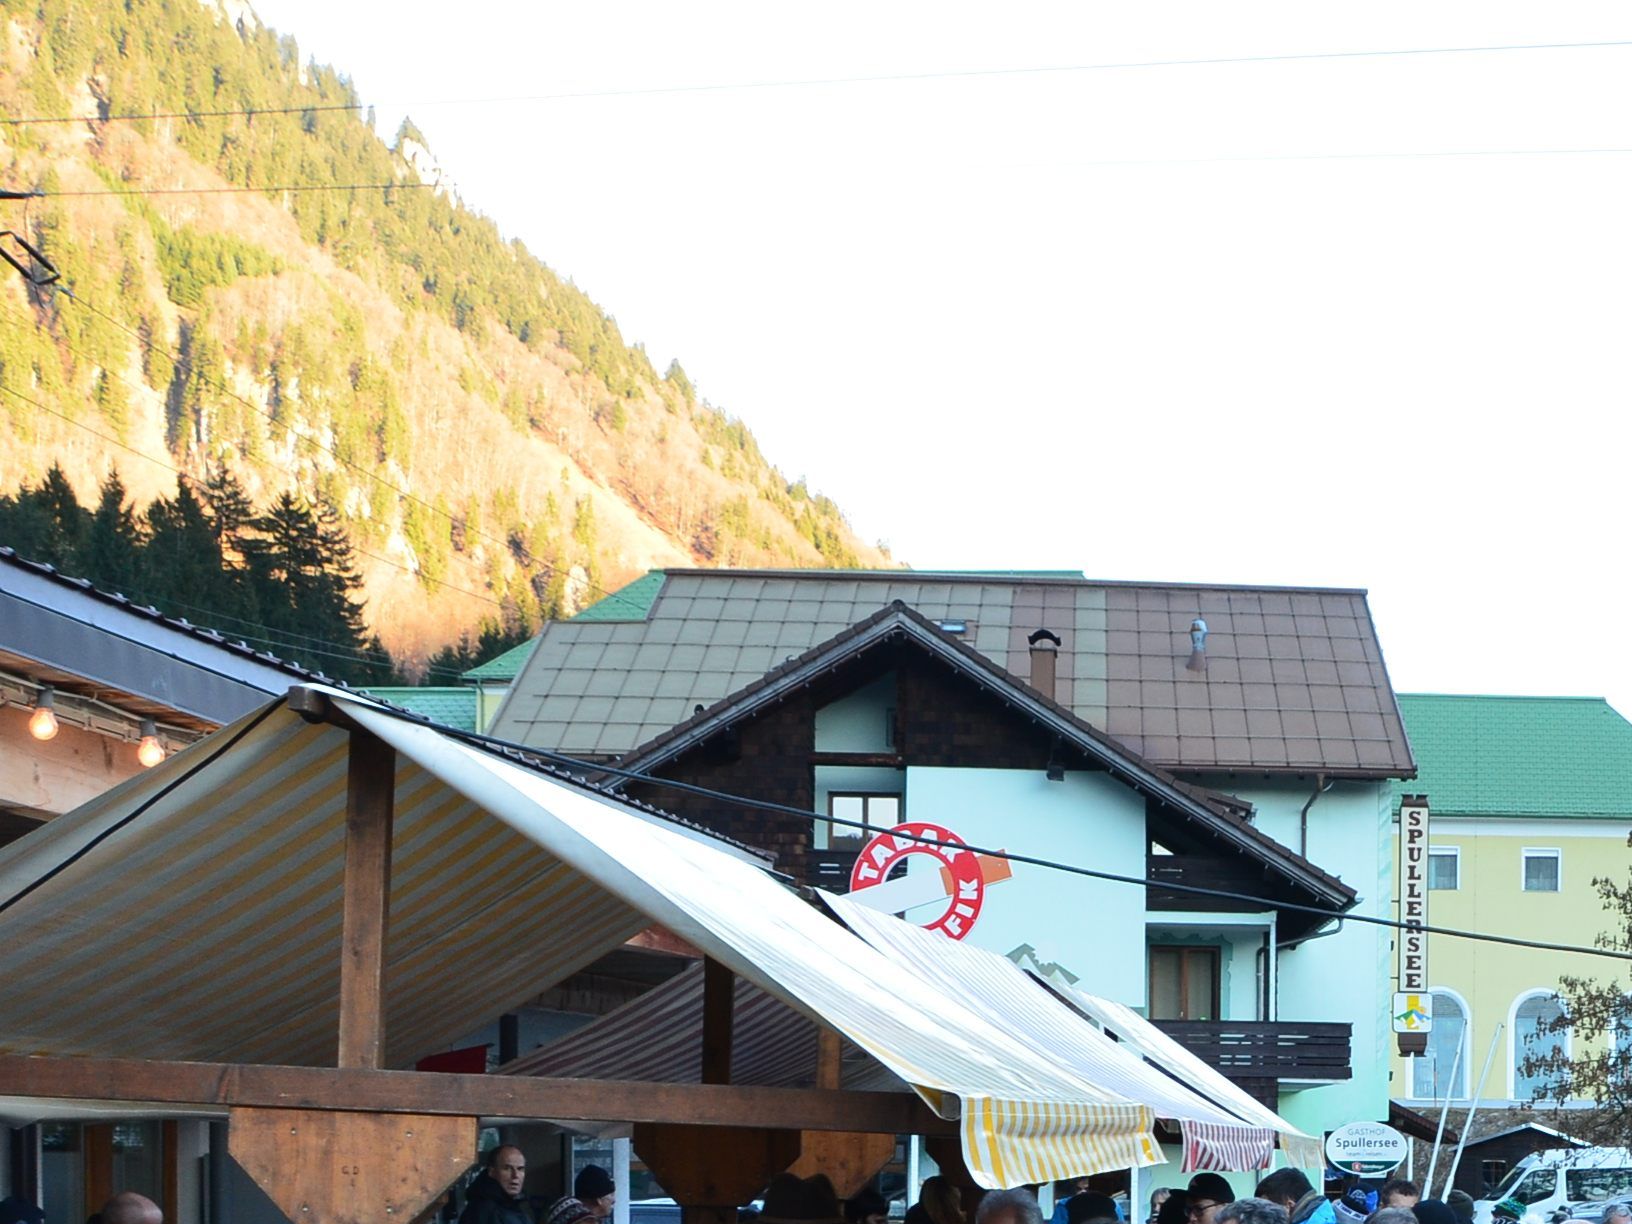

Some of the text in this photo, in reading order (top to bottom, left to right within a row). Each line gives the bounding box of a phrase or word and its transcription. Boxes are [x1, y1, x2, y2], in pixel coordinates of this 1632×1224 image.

[1405, 811, 1423, 988] SPULLERSEE
[1347, 1128, 1386, 1136] GASTHOF
[1335, 1137, 1399, 1150] Spullersee
